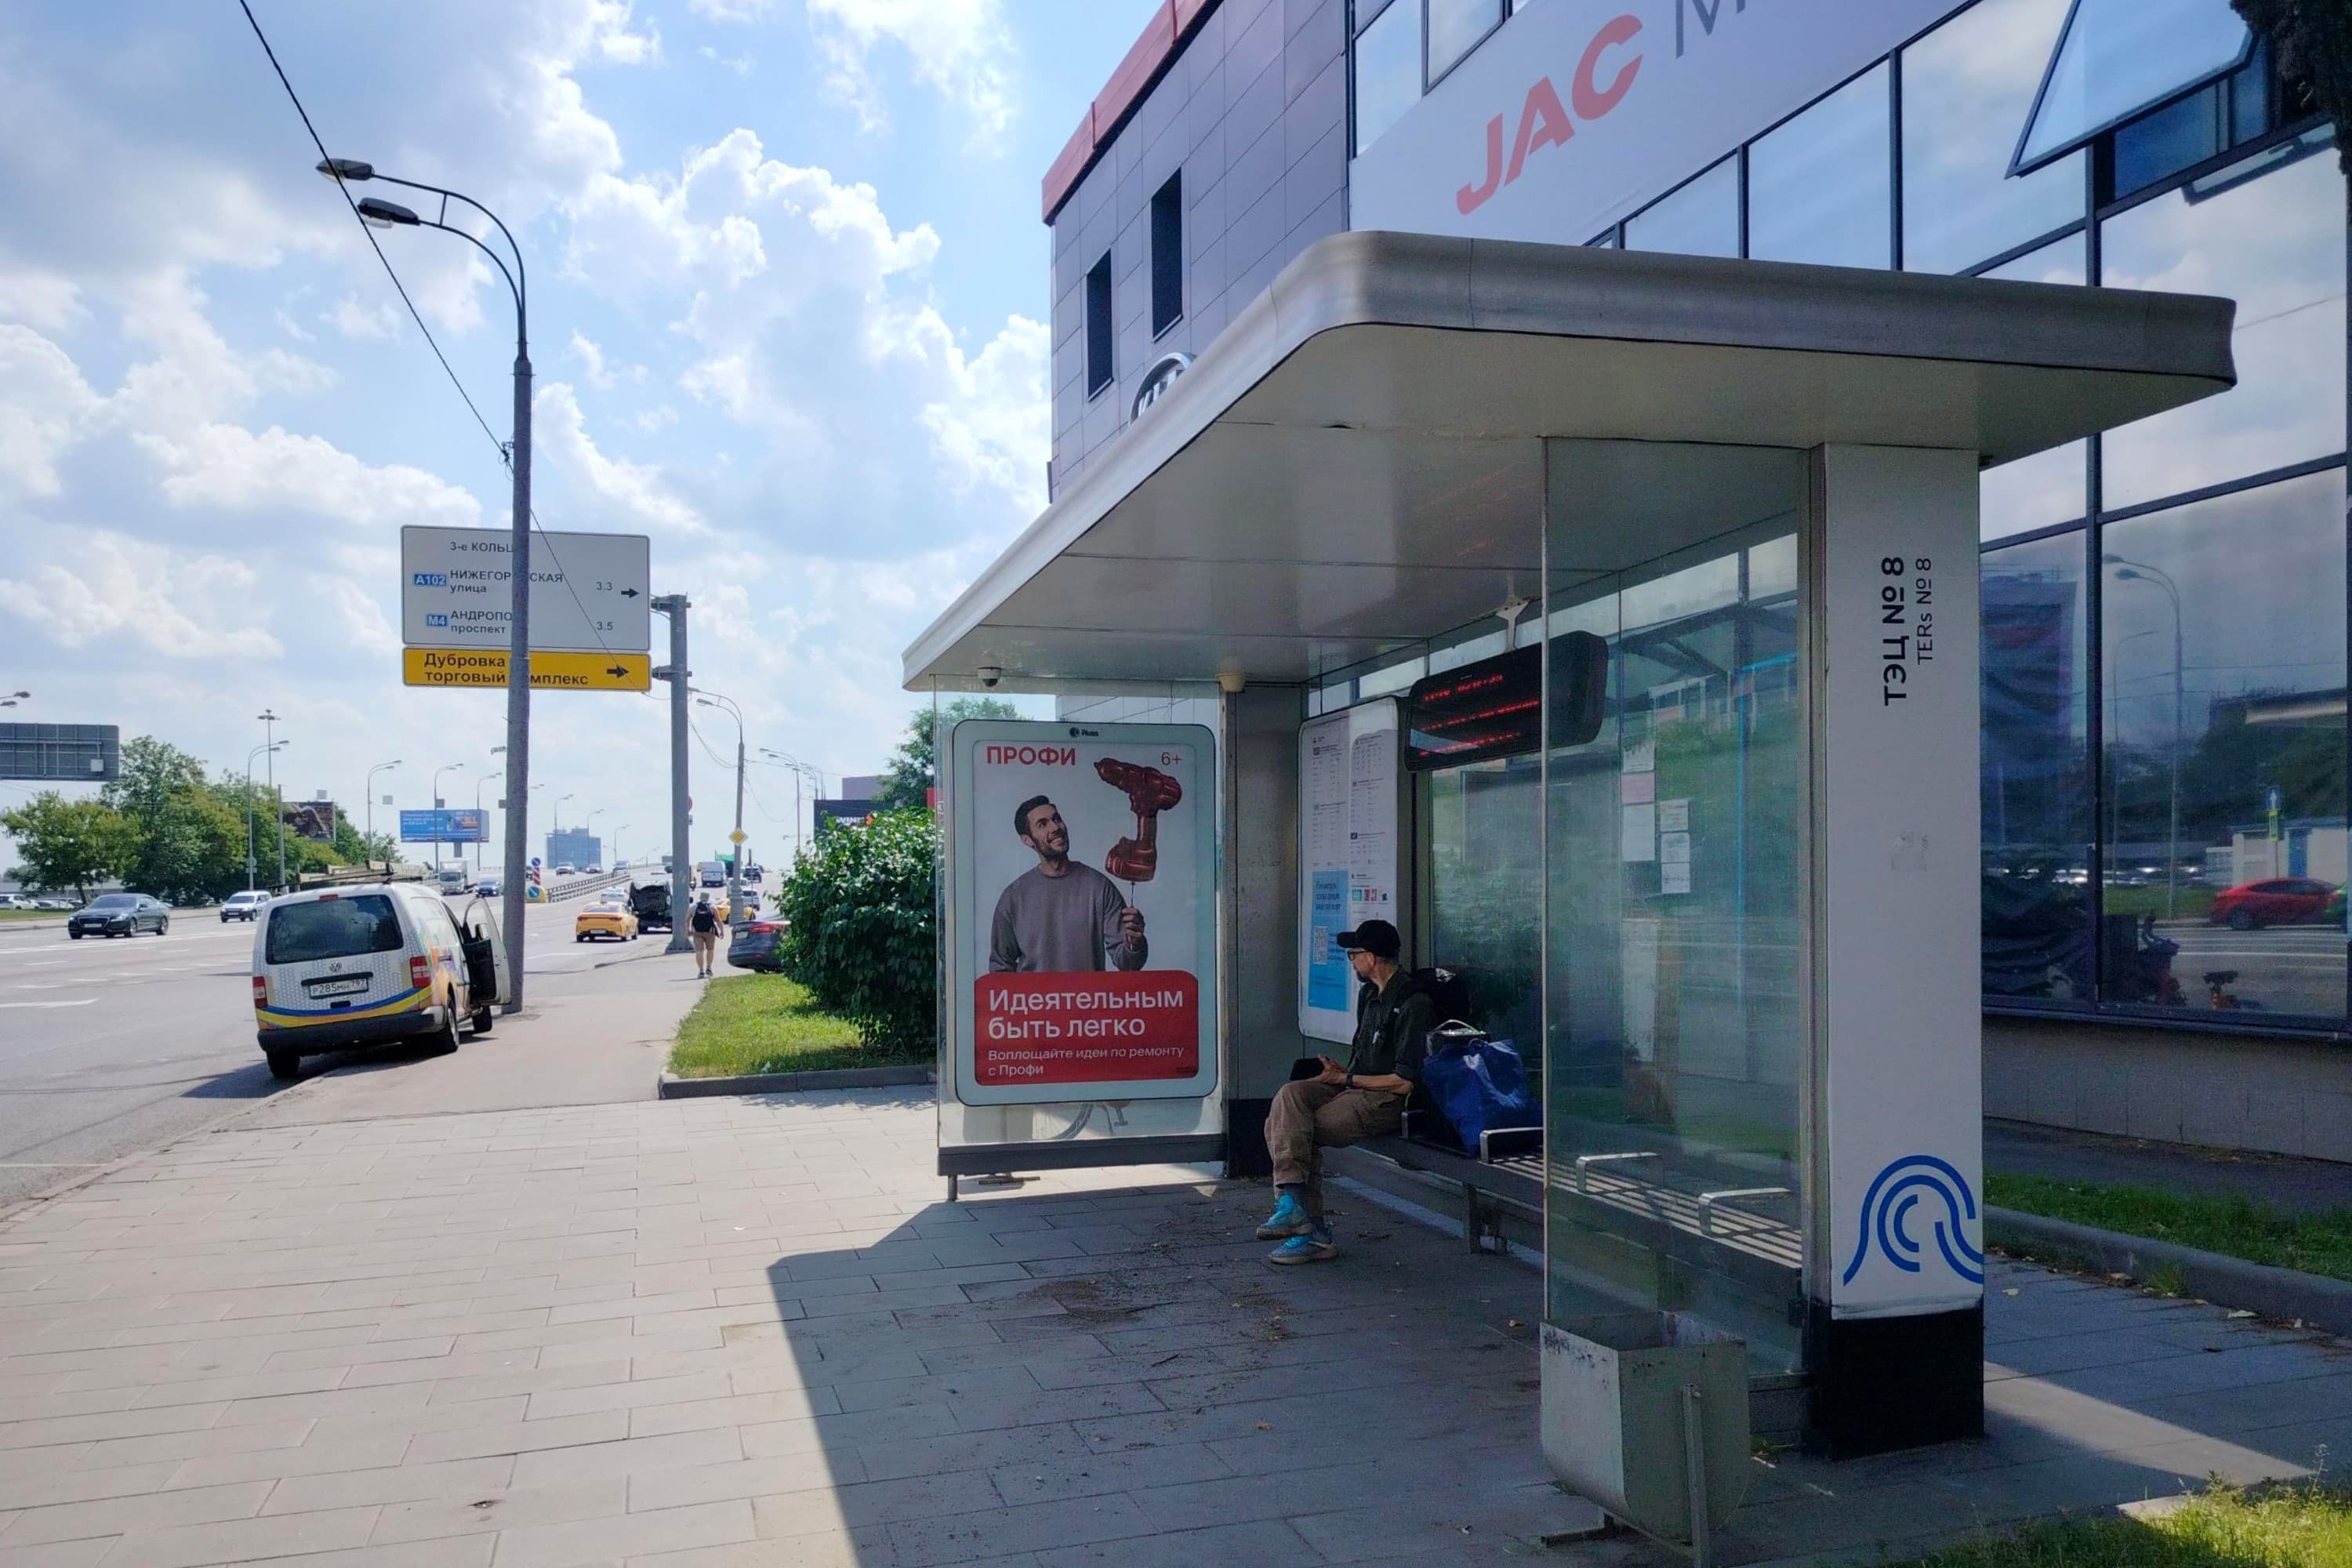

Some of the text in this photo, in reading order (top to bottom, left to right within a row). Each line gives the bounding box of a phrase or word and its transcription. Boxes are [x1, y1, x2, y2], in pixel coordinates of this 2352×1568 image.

[1455, 13, 1643, 216] JAC
[450, 541, 514, 554] 3-е КОЛЬЦ
[1882, 557, 1904, 576] 8
[1915, 557, 1931, 572] 8
[450, 570, 564, 584] НИЖЕГОРСКАЯ
[450, 584, 487, 594] улица
[596, 582, 613, 591] 3.3
[450, 610, 514, 622] АНДРОПО
[450, 623, 506, 635] проспект
[596, 622, 613, 631] 3.5
[424, 653, 506, 670] Дубровка
[426, 670, 589, 685] торговый мплекс
[1883, 635, 1910, 706] ТЭЦ
[985, 746, 1077, 767] ПРОФИ
[1160, 751, 1182, 767] 6+
[989, 989, 1184, 1015] Идеятельным
[988, 1016, 1146, 1040] быть легко
[988, 1046, 1185, 1061] Воплощайте идеи по ремонту
[988, 1064, 1044, 1077] с Профи
